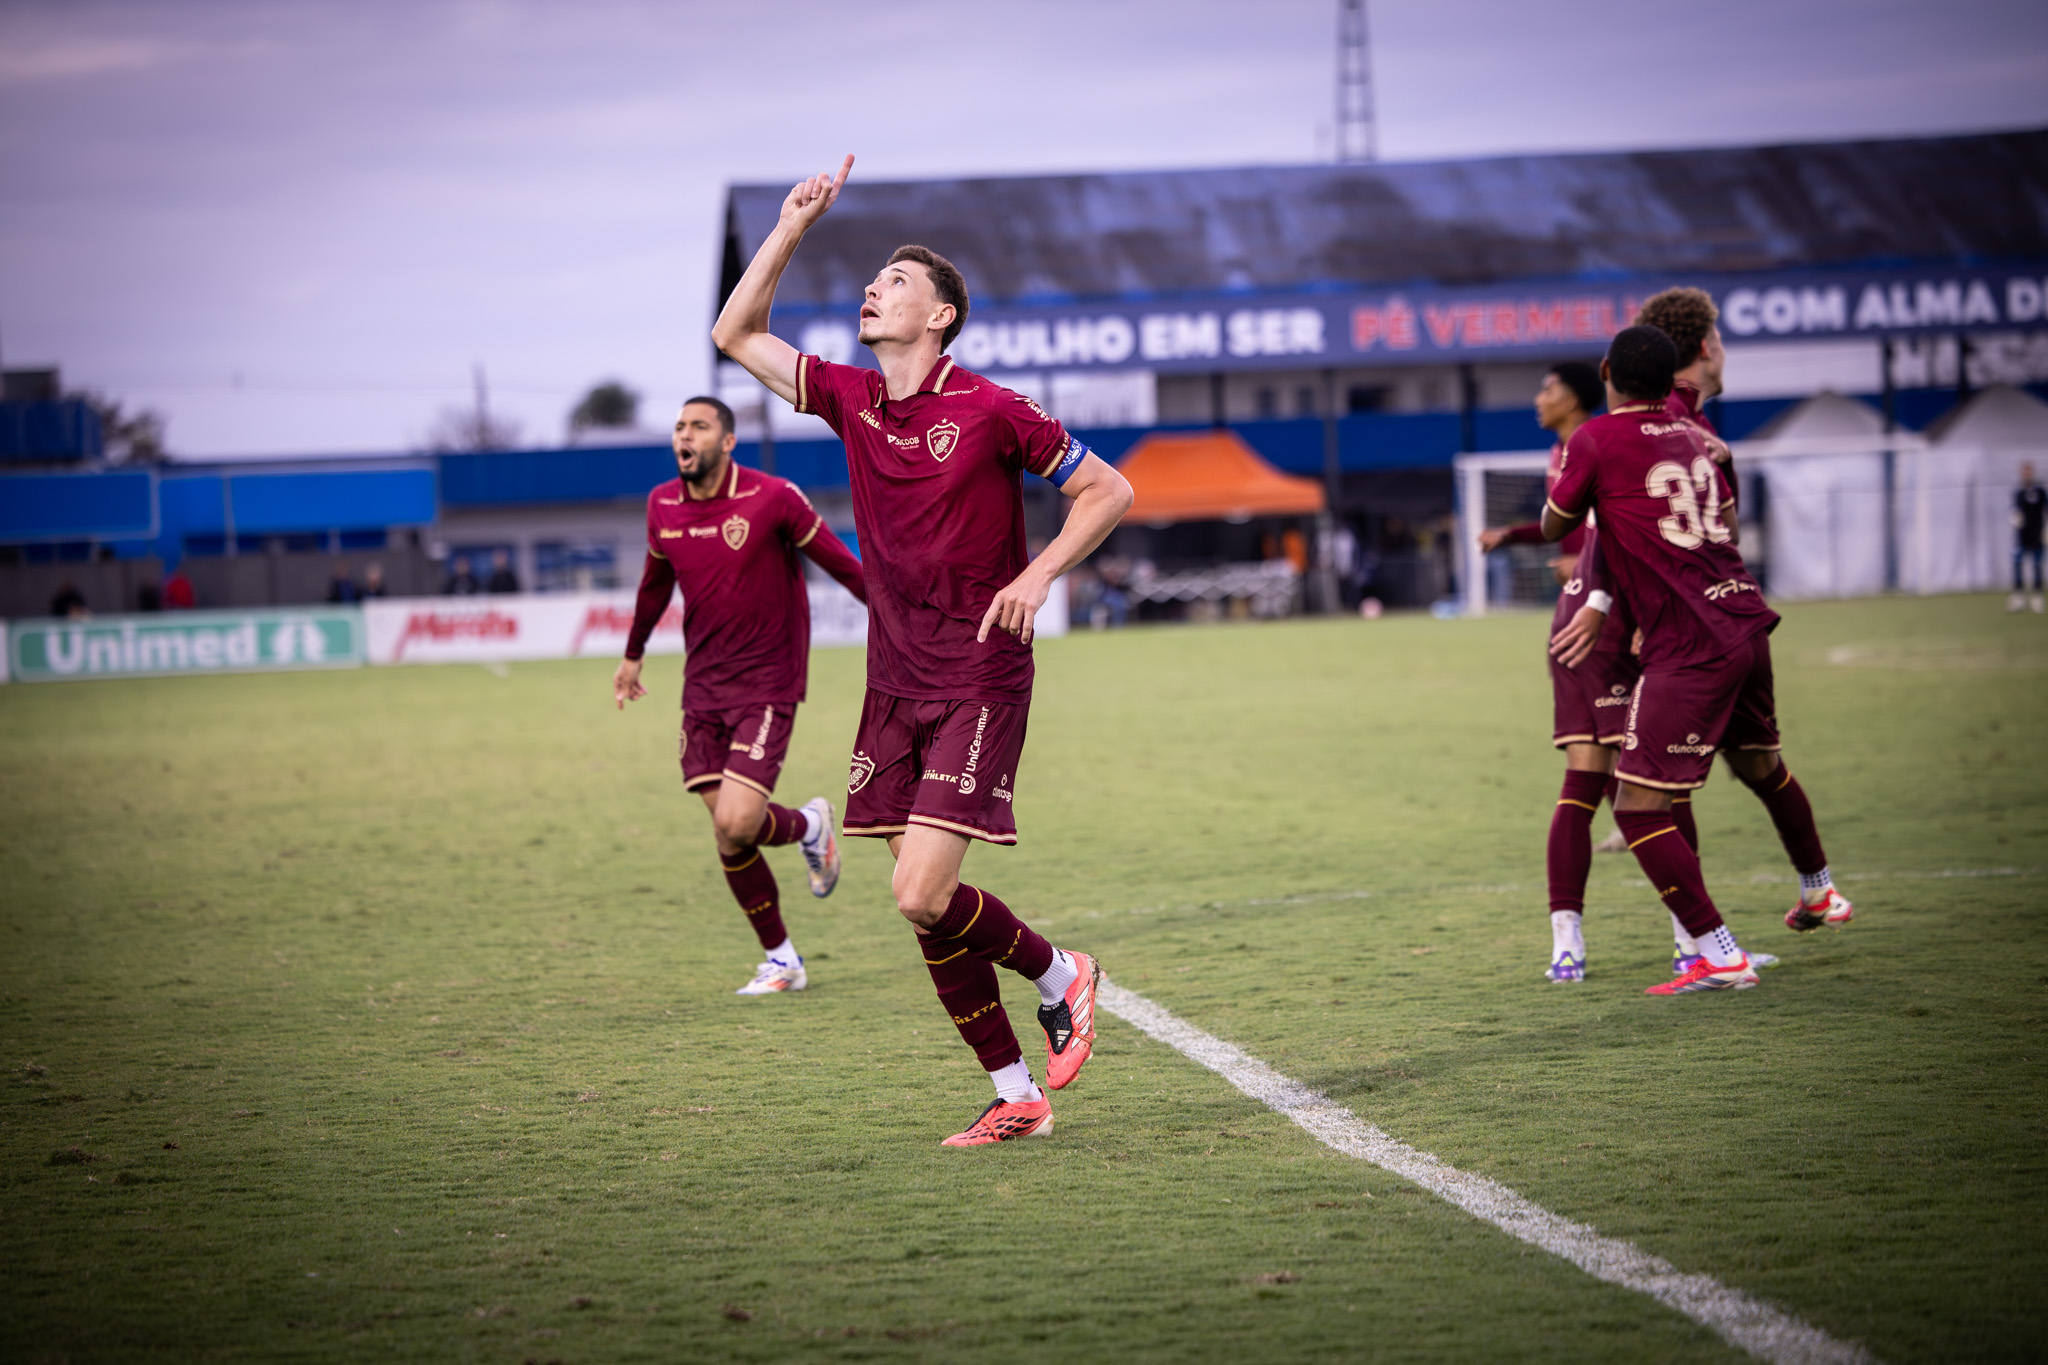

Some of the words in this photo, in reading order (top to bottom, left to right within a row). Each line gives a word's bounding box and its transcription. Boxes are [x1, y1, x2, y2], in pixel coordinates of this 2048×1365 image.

[955, 315, 1136, 371] GULHO
[1138, 311, 1222, 361] EM
[1225, 307, 1326, 357] SER
[1423, 298, 1648, 349] VERMEL
[1722, 286, 1845, 335] COM
[1853, 279, 2000, 330] ALMA
[2005, 275, 2048, 325] D
[858, 410, 882, 431] ATHLE
[1645, 455, 1731, 551] 32
[45, 619, 258, 675] Unimed
[966, 706, 990, 772] UniCesumar
[923, 772, 957, 784] ATHLETA
